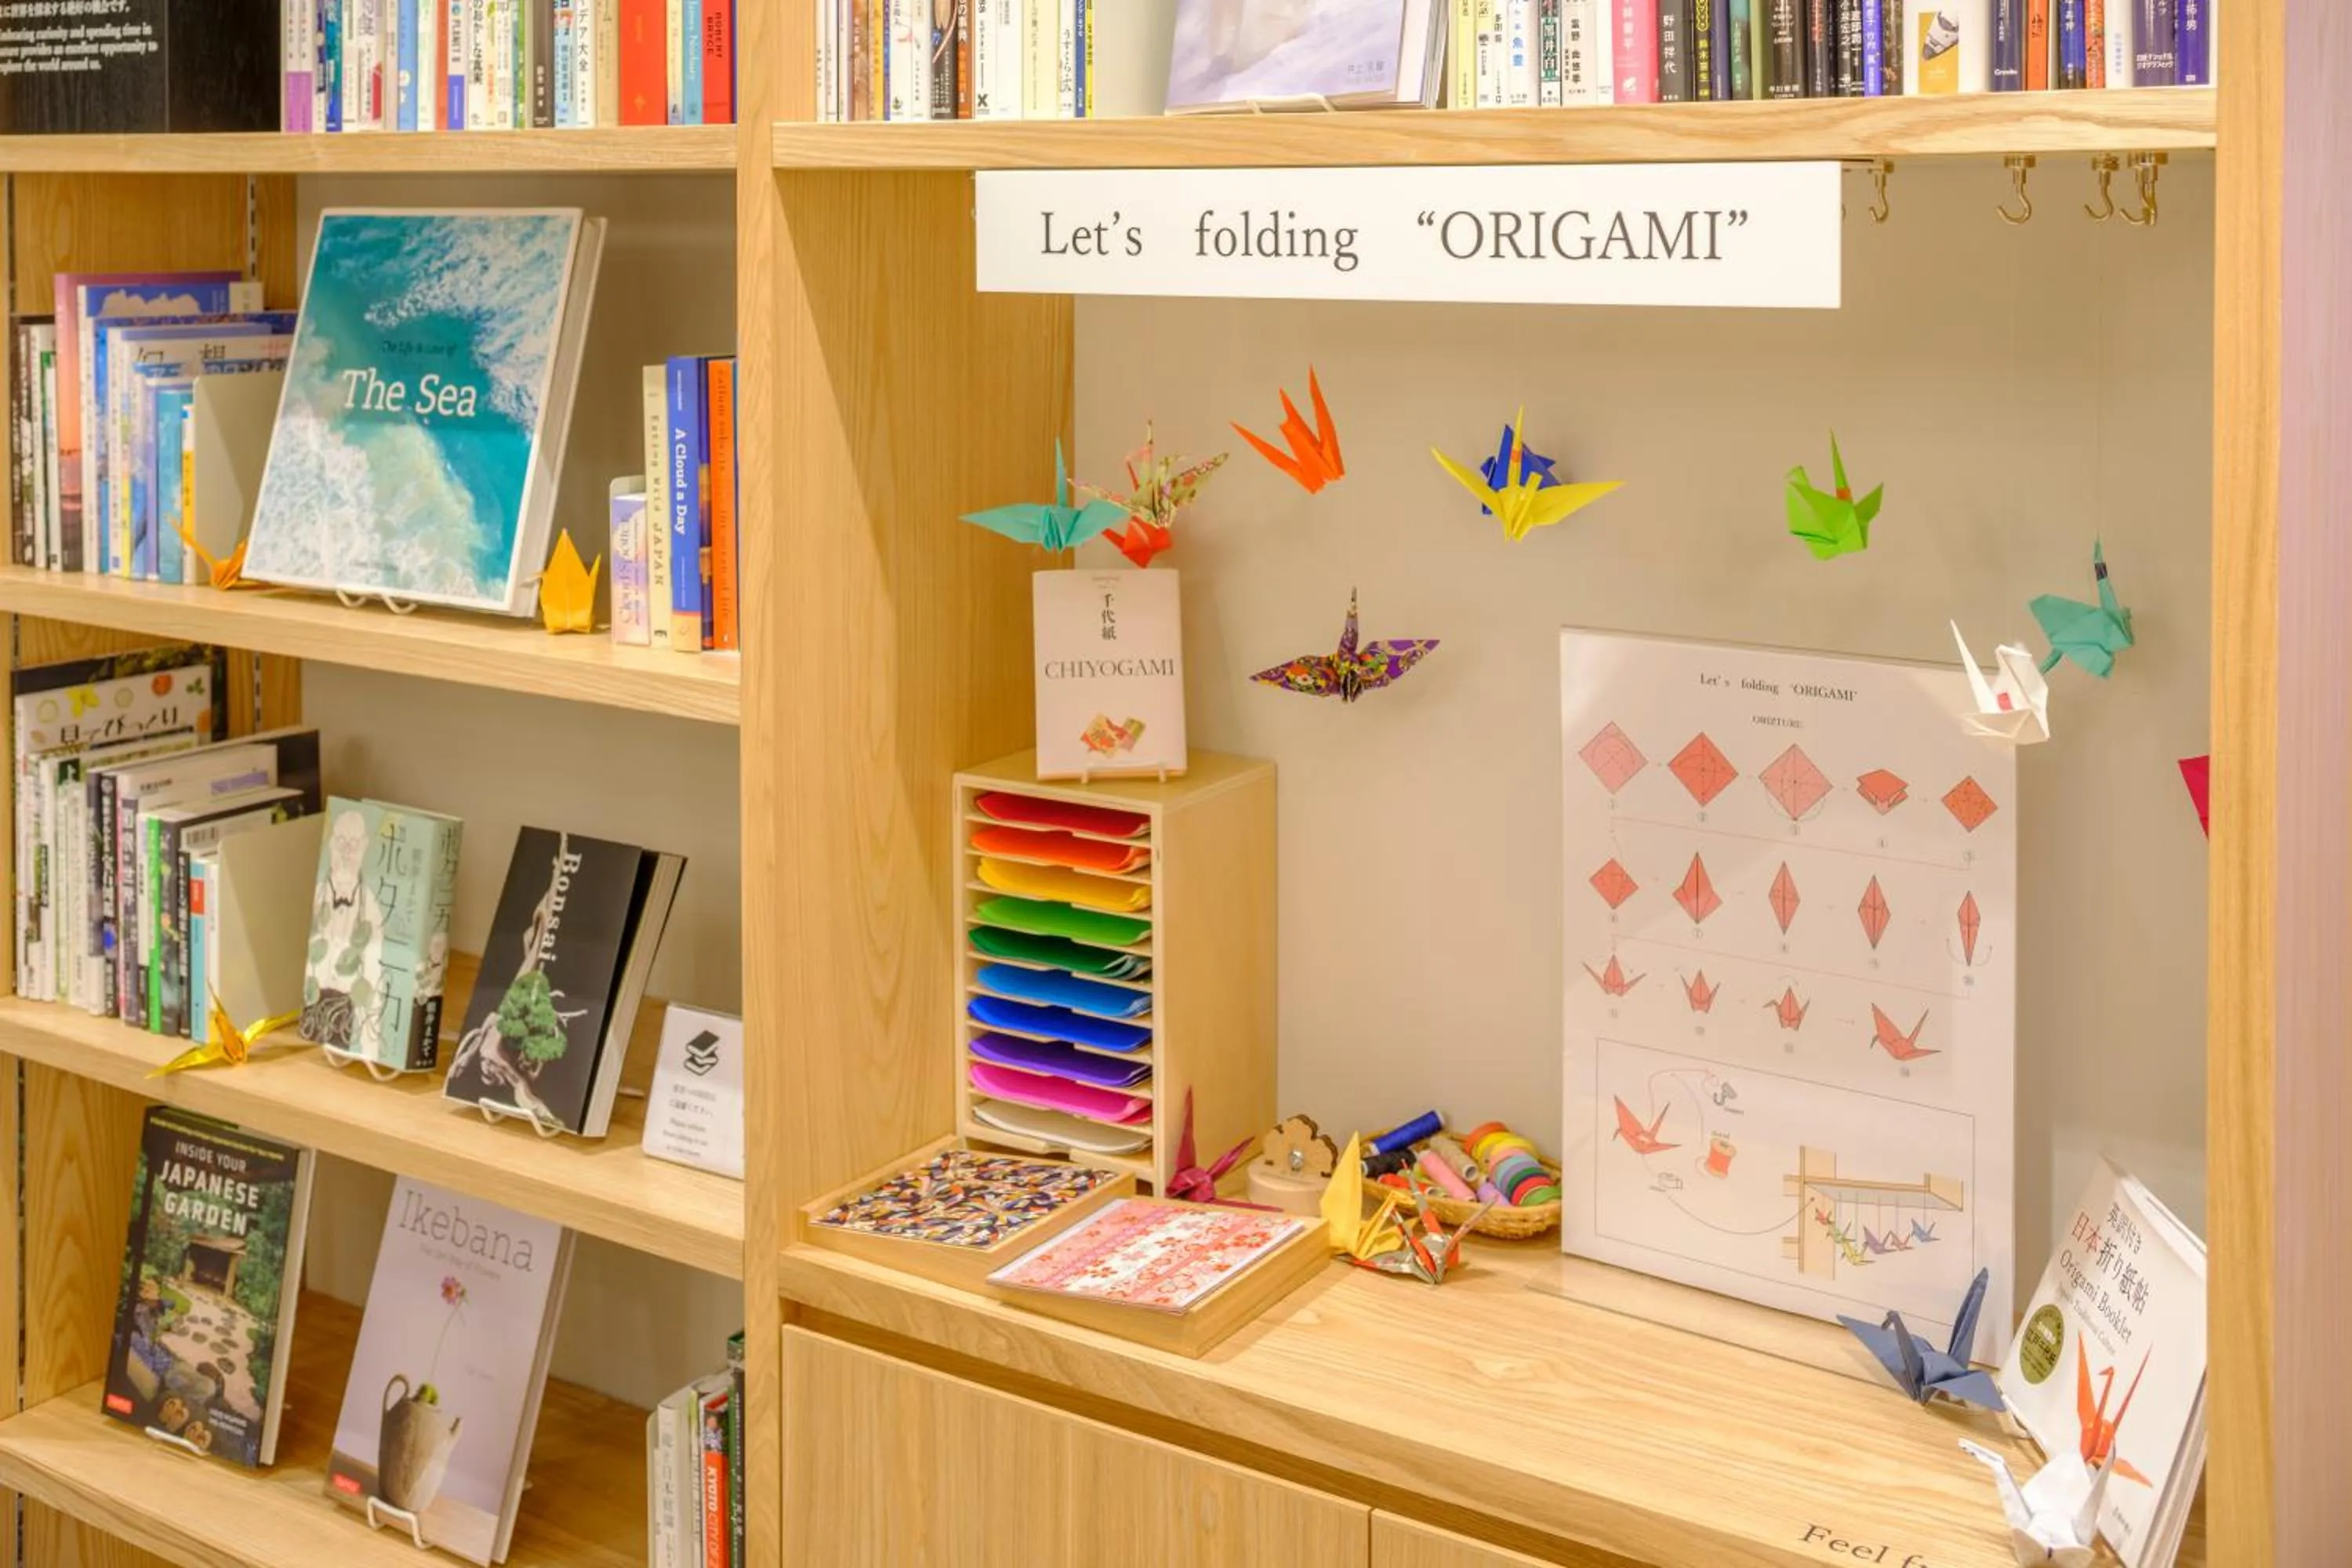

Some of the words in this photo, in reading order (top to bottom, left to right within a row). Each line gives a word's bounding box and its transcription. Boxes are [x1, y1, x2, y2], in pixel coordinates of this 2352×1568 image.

[36, 26, 68, 41] curiosity
[69, 24, 85, 39] and
[85, 23, 122, 40] spending
[0, 60, 23, 75] xplore
[1040, 210, 1142, 257] Let’s
[1194, 209, 1359, 272] folding
[1417, 209, 1748, 262] “ORIGAMI”
[343, 367, 405, 412] The
[416, 373, 477, 417] Sea
[674, 427, 687, 440] A
[674, 442, 688, 488] Cloud
[676, 490, 686, 501] a
[674, 504, 688, 535] Day
[652, 522, 665, 586] JAPAN
[1101, 593, 1117, 641] 千代紙
[1044, 658, 1174, 679] CHIYOGAMI
[1741, 679, 1779, 695] folding
[538, 852, 583, 961] Bonsai
[175, 1141, 214, 1164] INSIDE
[216, 1152, 247, 1173] YOUR
[159, 1160, 260, 1210] JAPANESE
[164, 1192, 249, 1236] GARDEN
[397, 1189, 535, 1273] Ikebana
[2059, 1248, 2101, 1302] Origami
[2096, 1290, 2132, 1344] Booklet
[707, 1466, 718, 1512] KYOTO
[1797, 1523, 1889, 1563] Feel
